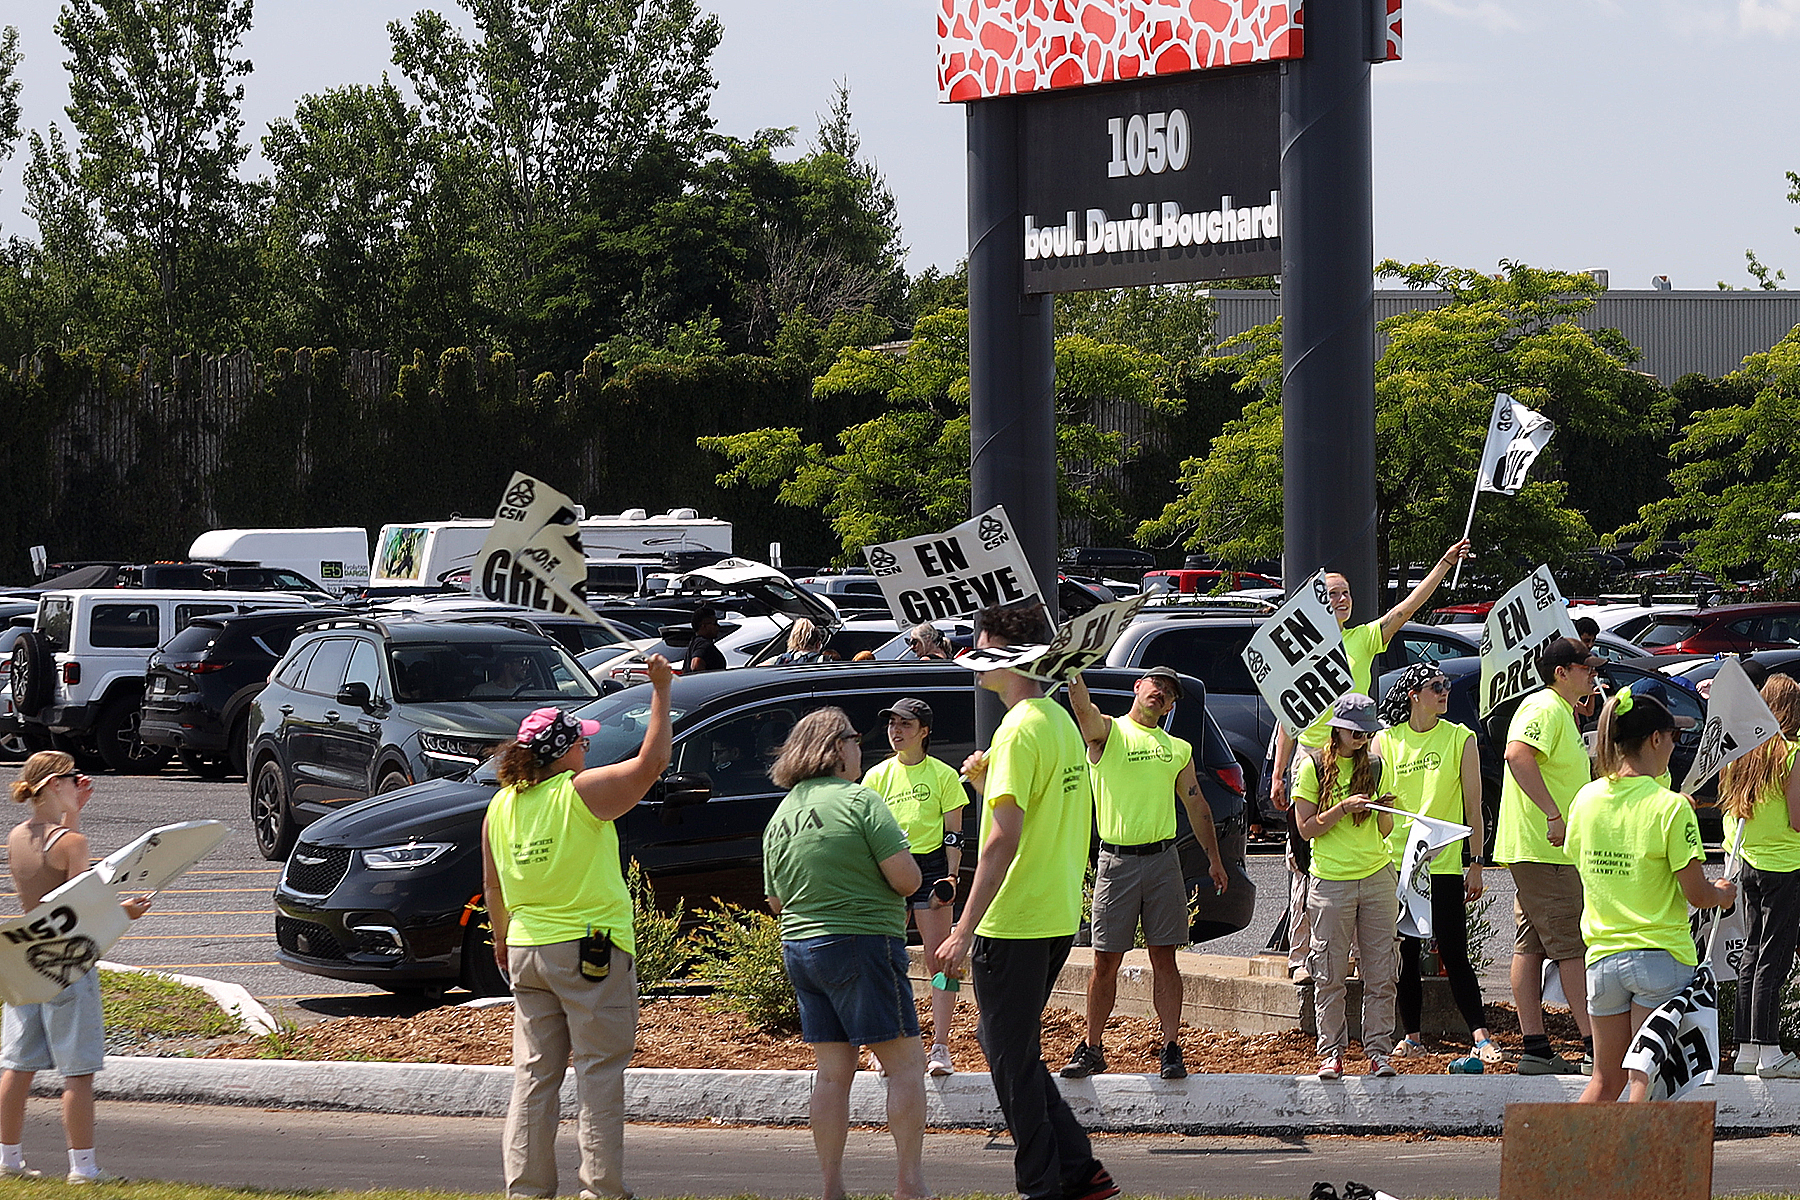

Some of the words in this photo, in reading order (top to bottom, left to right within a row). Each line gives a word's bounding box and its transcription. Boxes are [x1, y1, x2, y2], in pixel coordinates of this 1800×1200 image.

[1107, 108, 1191, 178] 1050
[1024, 211, 1085, 261] boul.
[1086, 190, 1281, 255] David-Bouchard
[499, 506, 527, 522] CSN
[913, 536, 970, 578] EN
[984, 532, 1010, 551] CSN
[875, 565, 903, 577] CSN
[899, 566, 1024, 624] GRÈVE
[1536, 592, 1557, 611] CSN
[1268, 608, 1325, 667] EN
[1497, 596, 1532, 651] EN
[1256, 663, 1272, 684] CSN
[1279, 643, 1352, 729] GRÈV
[1, 905, 78, 944] CSN
[1725, 938, 1748, 951] SN
